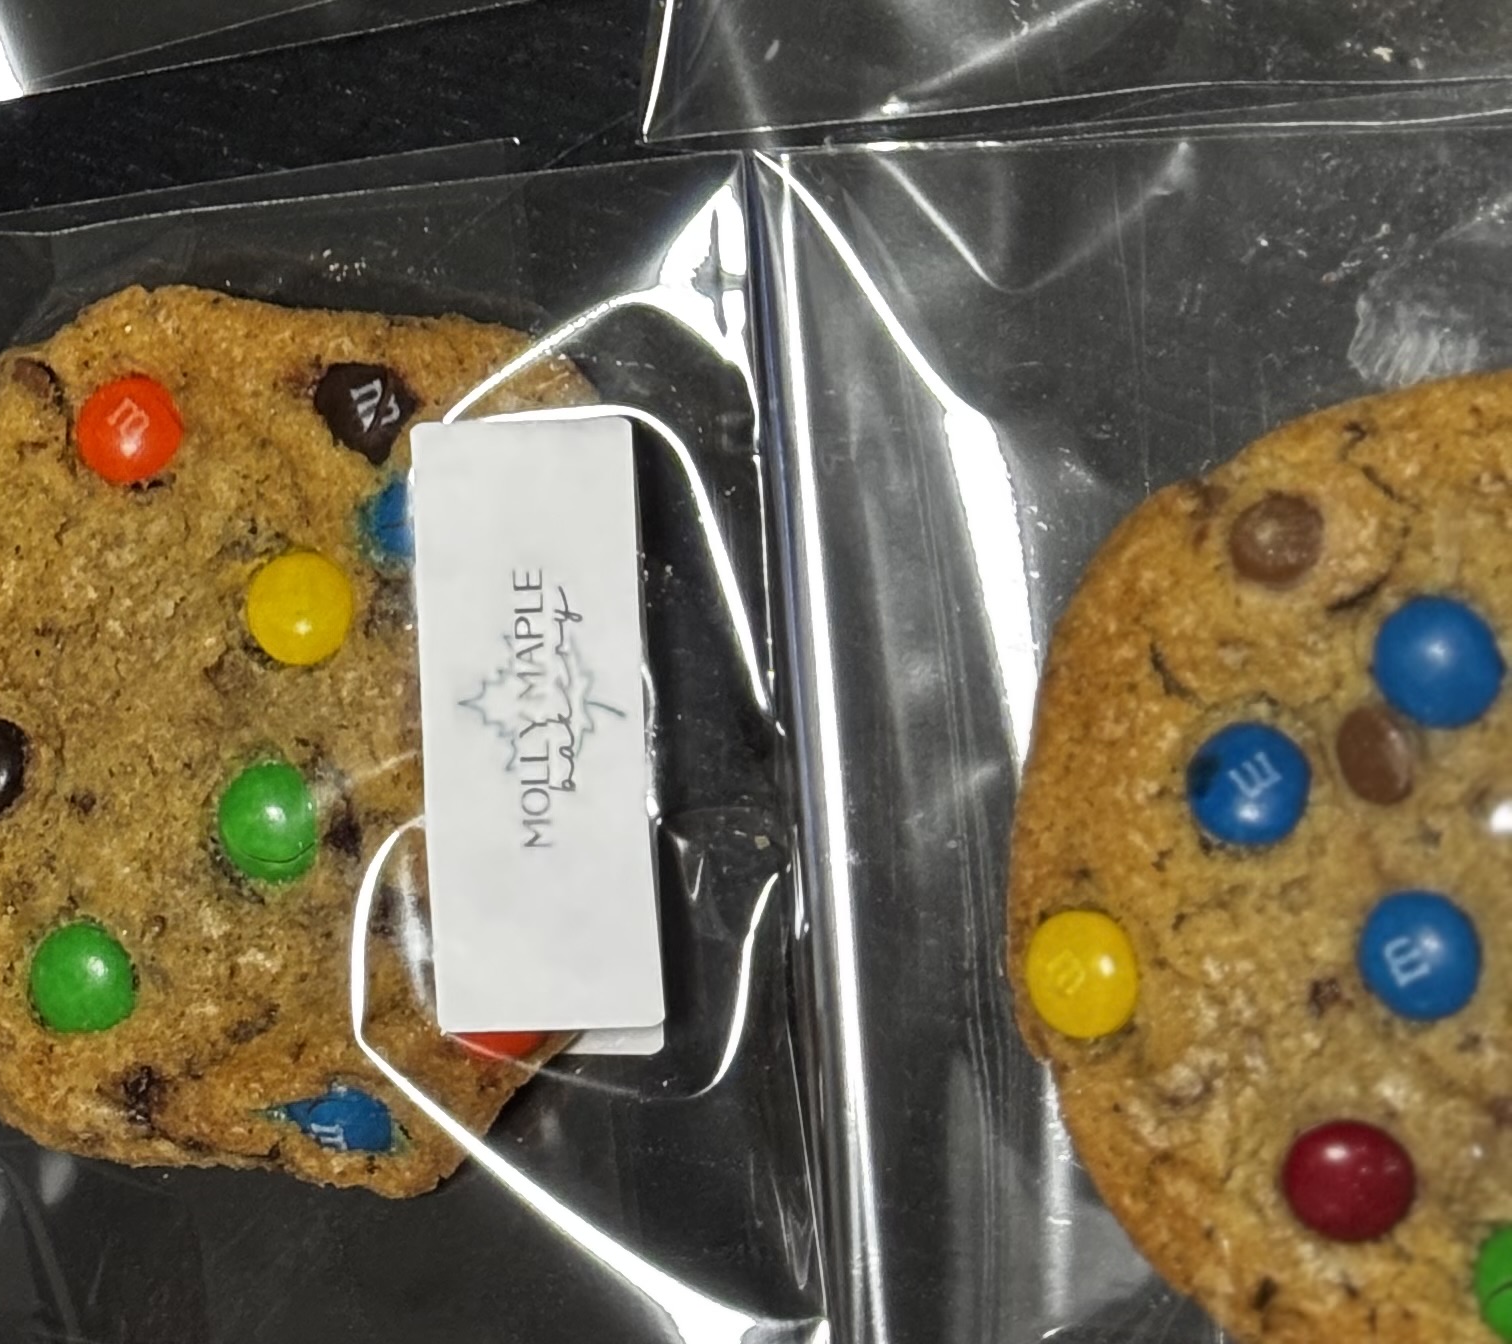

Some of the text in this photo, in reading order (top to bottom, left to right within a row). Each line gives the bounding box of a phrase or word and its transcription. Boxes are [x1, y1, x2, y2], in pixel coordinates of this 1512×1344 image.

[512, 569, 553, 849] MOLLY MAPLE
[547, 586, 583, 792] bakery
[1229, 752, 1282, 798] m
[1384, 937, 1429, 987] m
